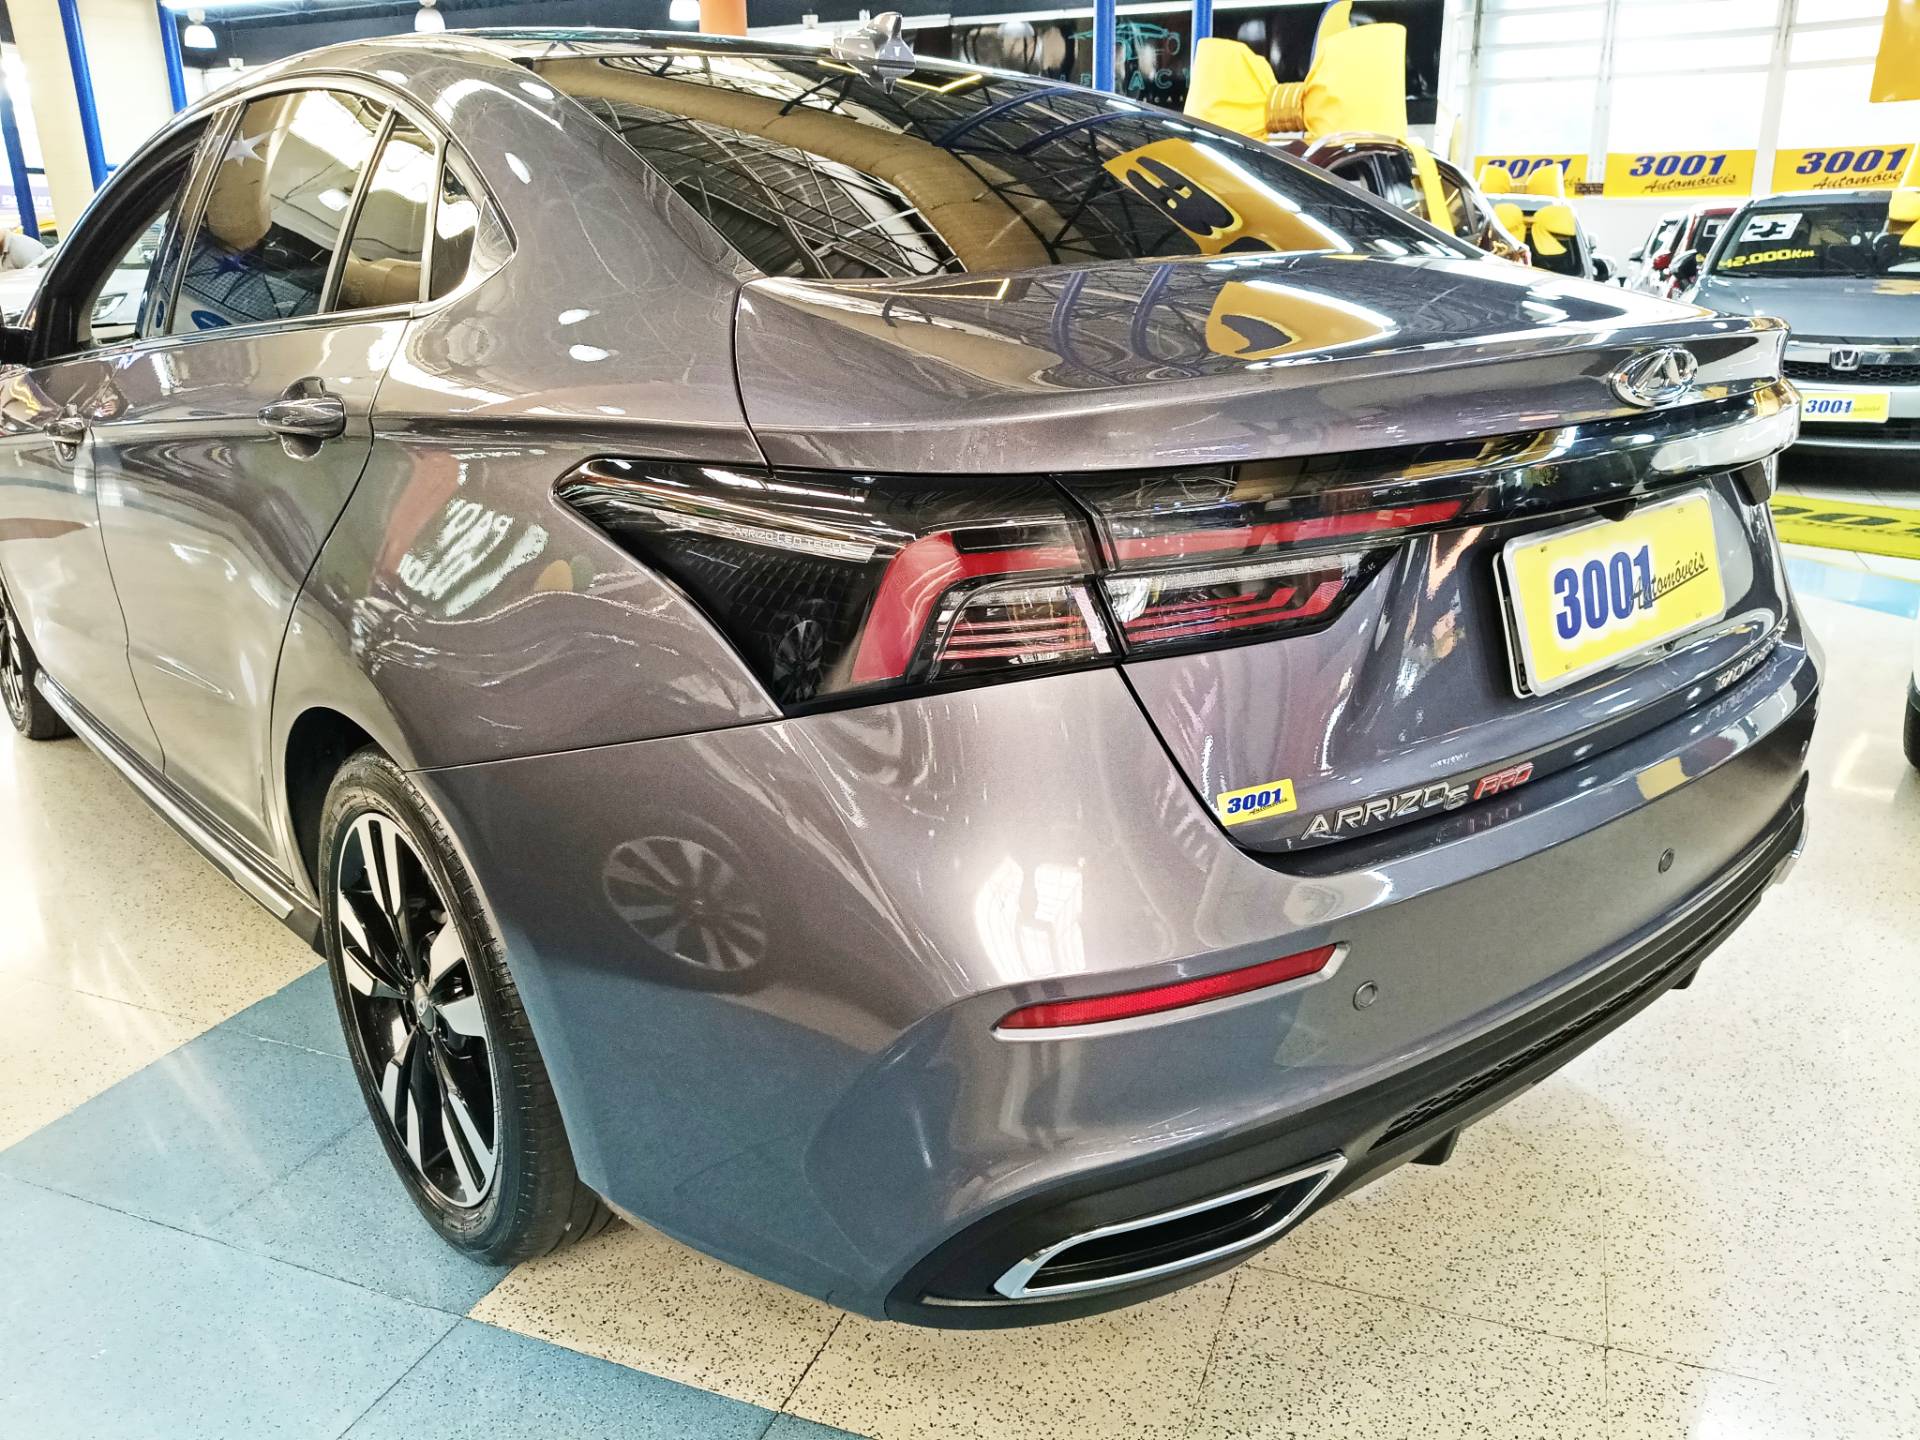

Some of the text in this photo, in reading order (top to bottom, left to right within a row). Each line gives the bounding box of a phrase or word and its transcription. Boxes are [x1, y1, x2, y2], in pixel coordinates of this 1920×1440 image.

[1629, 154, 1727, 177] 3001
[1796, 148, 1907, 175] 3001
[1805, 399, 1853, 414] 3001
[1553, 544, 1654, 640] 3001
[1227, 788, 1282, 814] 3001
